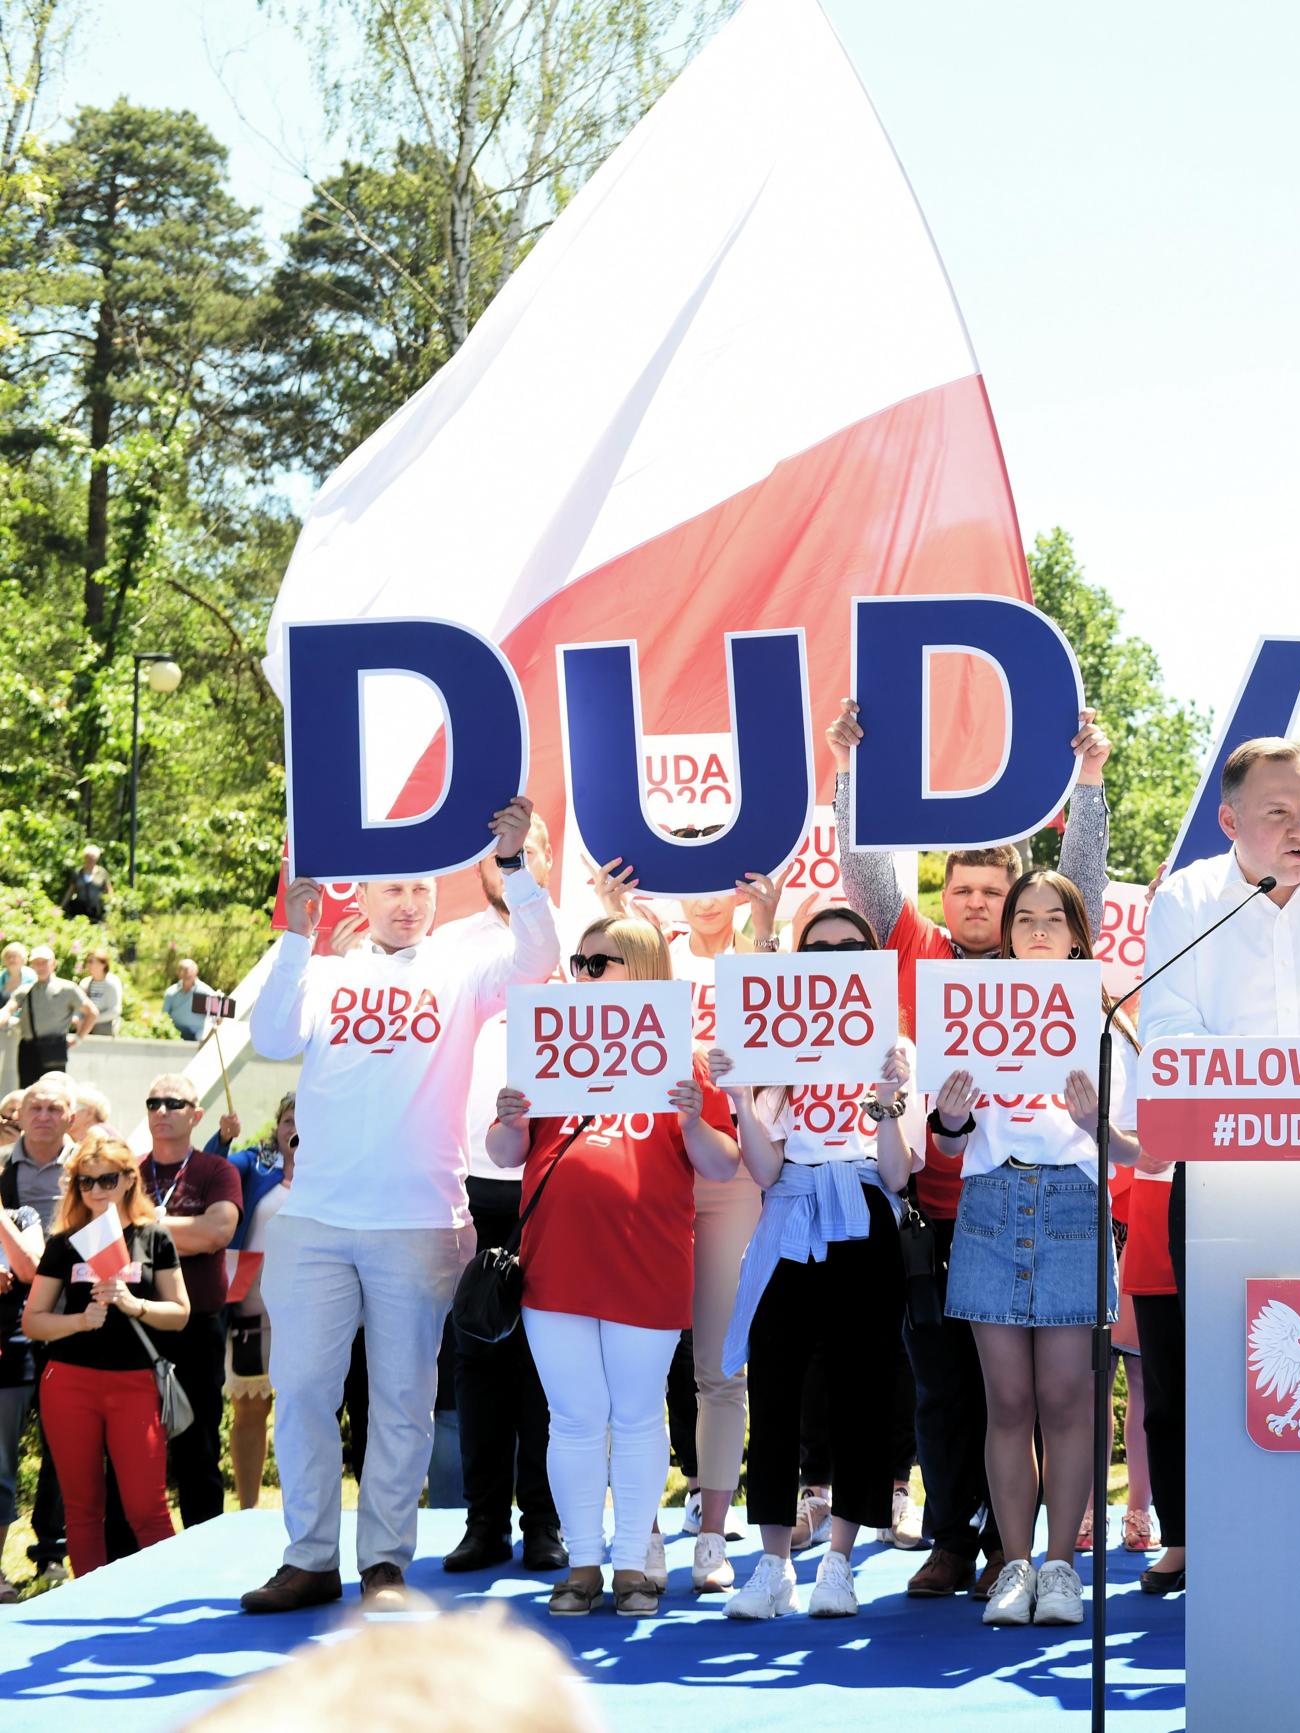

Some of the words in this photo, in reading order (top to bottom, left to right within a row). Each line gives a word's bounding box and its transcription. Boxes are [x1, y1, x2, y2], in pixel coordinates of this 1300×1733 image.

[645, 753, 729, 786] UDA
[330, 986, 439, 1015] DUDA
[742, 974, 872, 1011] DUDA
[943, 983, 1075, 1019] DUDA
[330, 1012, 441, 1045] 2020
[534, 1003, 665, 1042] DUDA
[743, 1010, 875, 1048] 2020
[943, 1020, 1077, 1057] 2020
[535, 1040, 668, 1079] 2020
